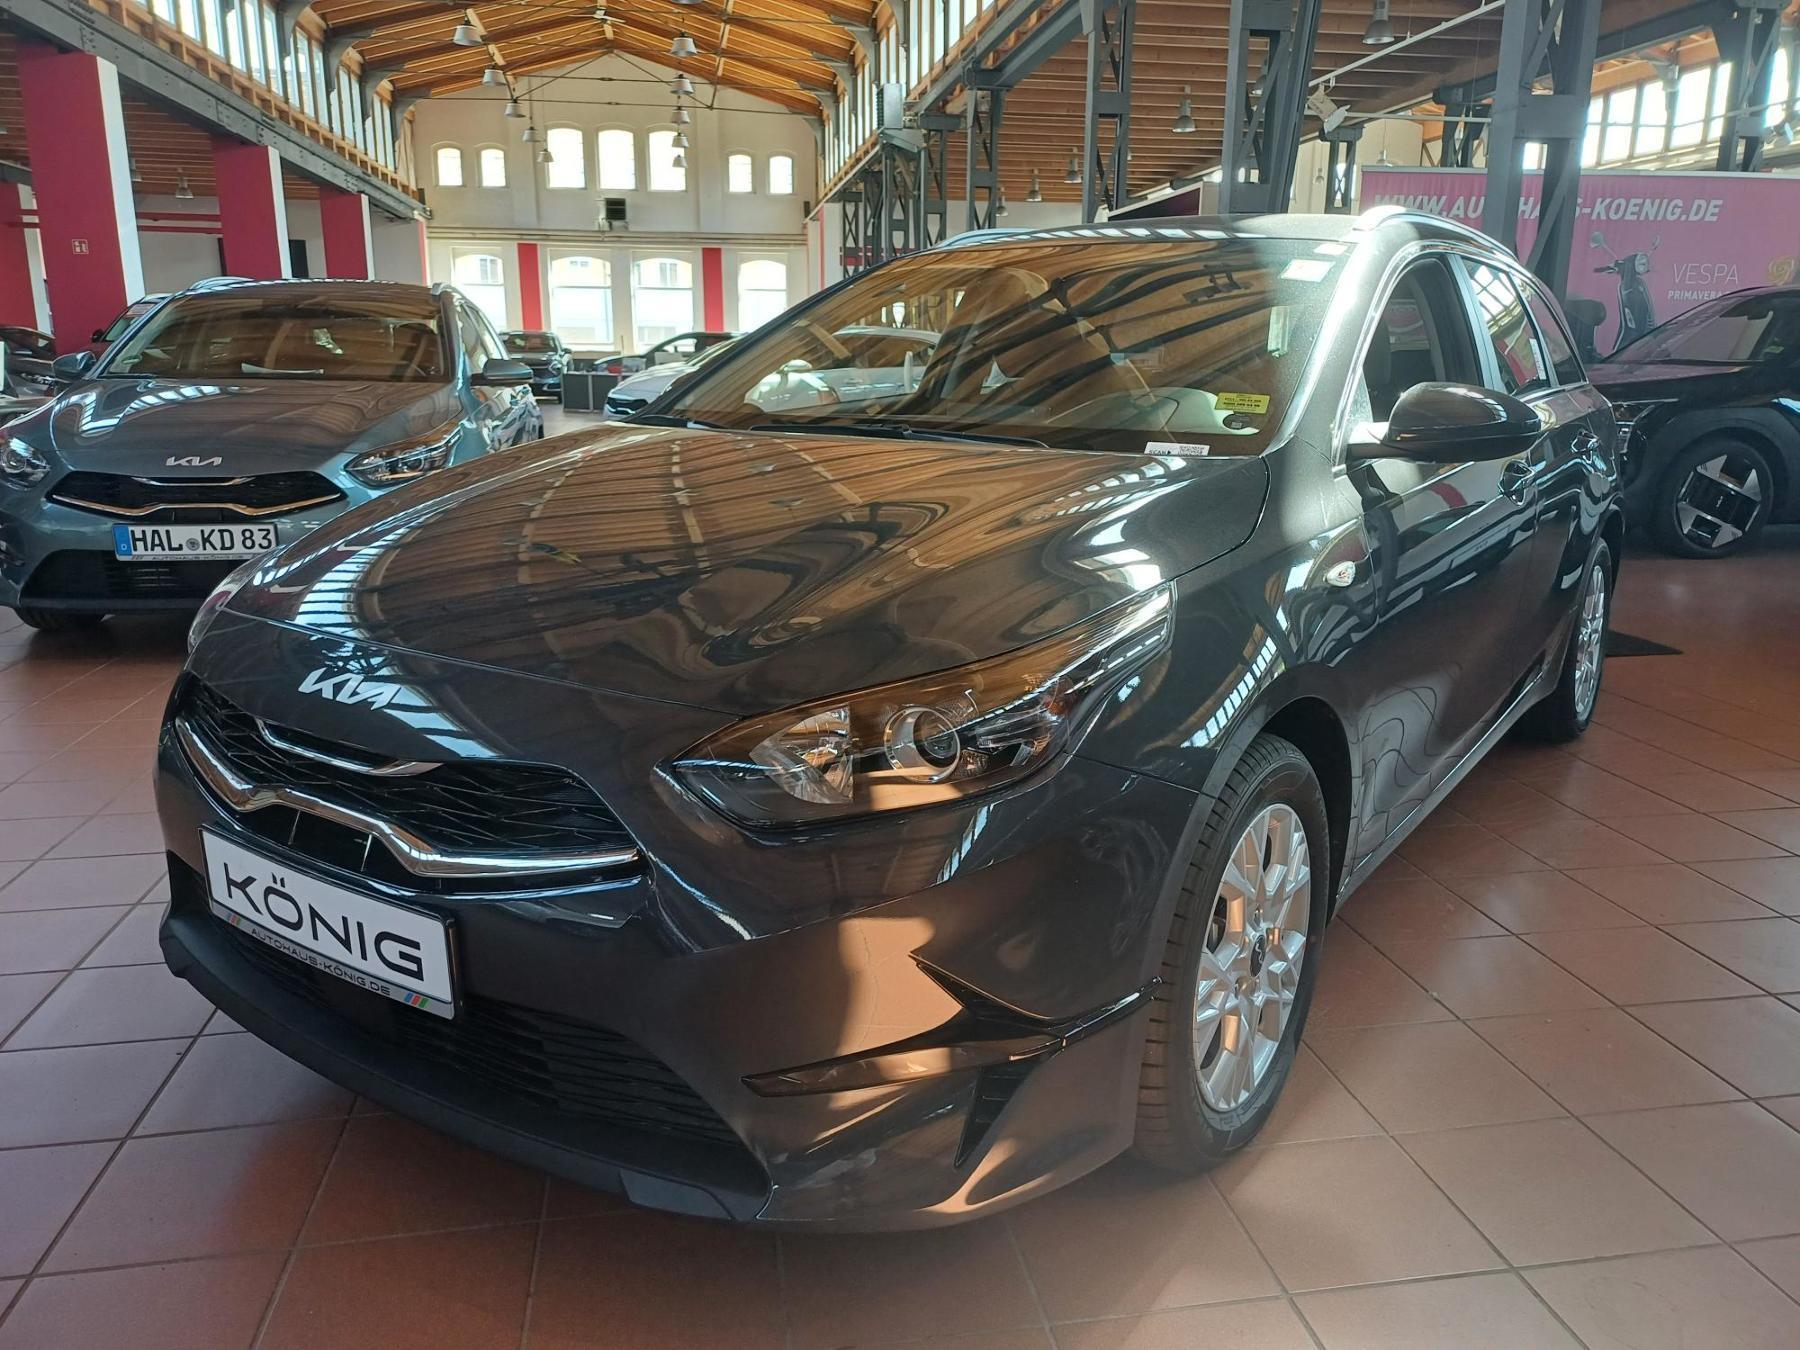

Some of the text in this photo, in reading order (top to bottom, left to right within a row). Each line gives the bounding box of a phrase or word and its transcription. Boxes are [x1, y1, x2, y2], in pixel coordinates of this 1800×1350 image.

[1374, 194, 1723, 222] WW.AUH-KOENIG.DE
[1673, 263, 1739, 285] VESPA
[165, 456, 223, 466] KIA
[130, 528, 273, 552] HAL KD 83
[298, 667, 402, 711] KIA
[223, 862, 425, 982] KÖNIG
